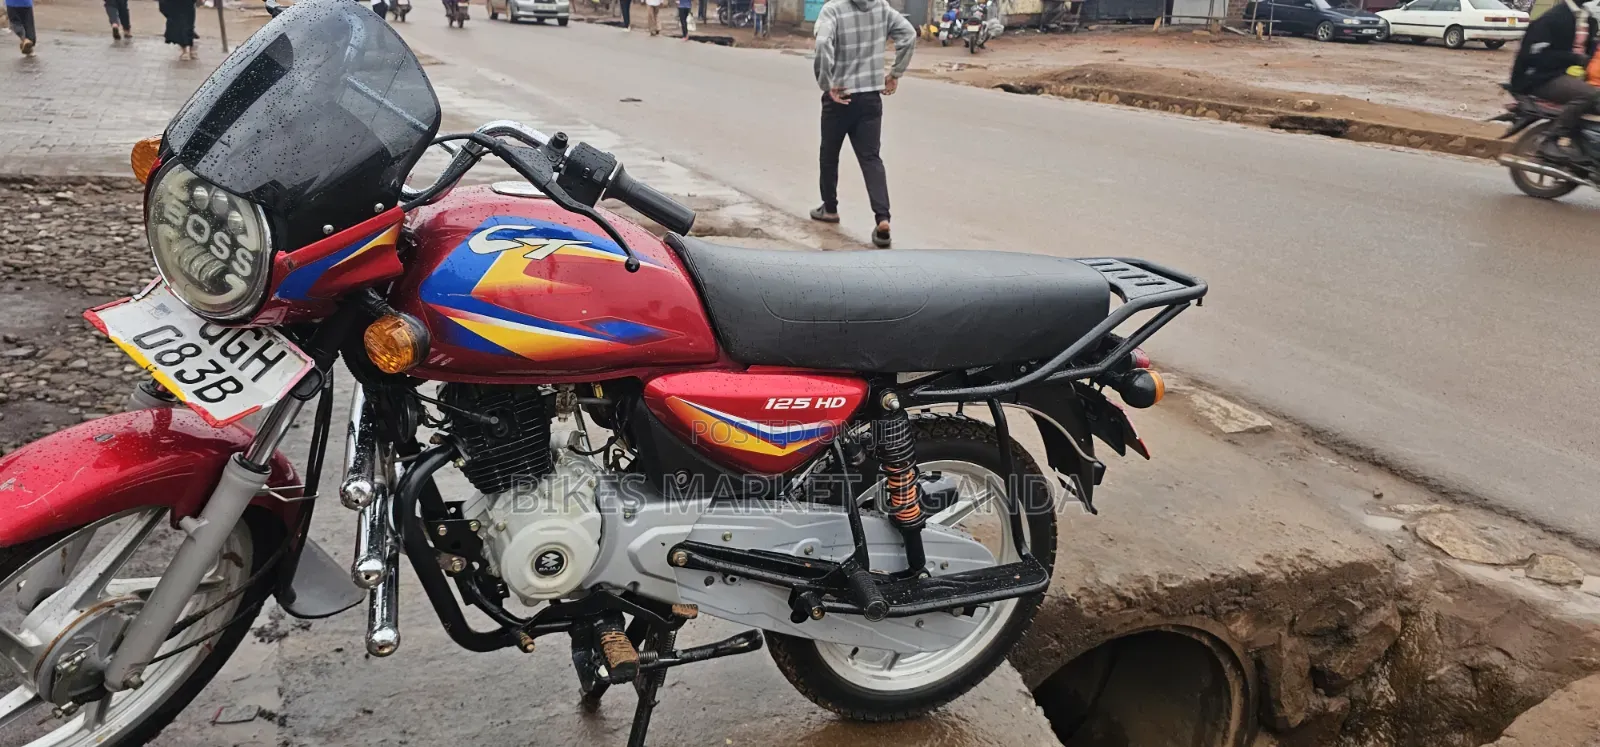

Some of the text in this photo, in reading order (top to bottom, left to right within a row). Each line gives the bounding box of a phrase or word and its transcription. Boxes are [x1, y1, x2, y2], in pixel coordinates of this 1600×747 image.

[163, 199, 254, 277] BOSS
[467, 224, 593, 261] CT
[132, 324, 244, 404] 083B
[764, 396, 847, 410] 125 HD
